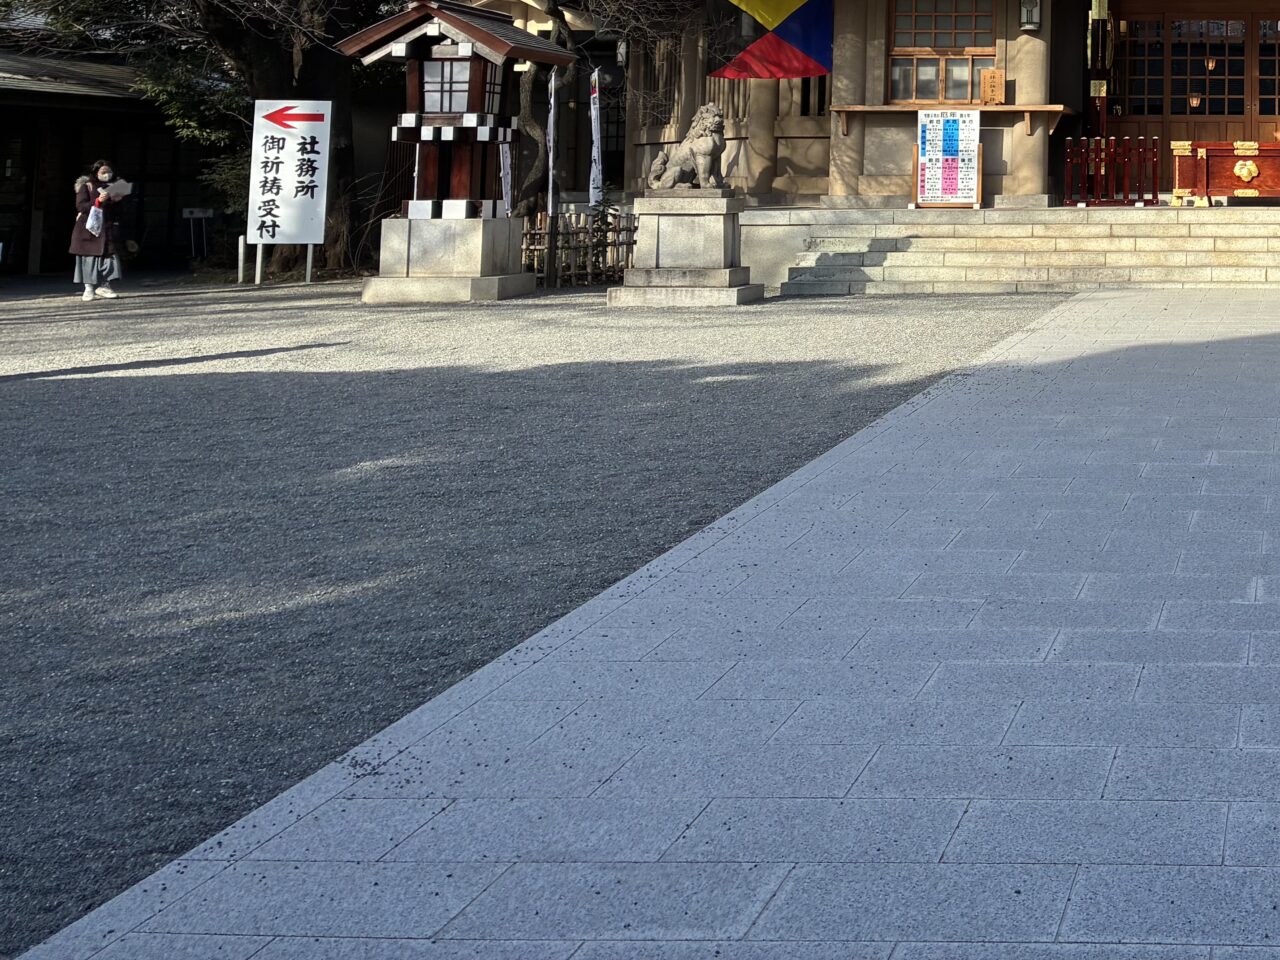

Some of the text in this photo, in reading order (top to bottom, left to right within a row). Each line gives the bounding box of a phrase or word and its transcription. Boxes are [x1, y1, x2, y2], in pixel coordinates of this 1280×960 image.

[256, 135, 286, 239] 御祈祷受付
[293, 135, 321, 200] 社務所
